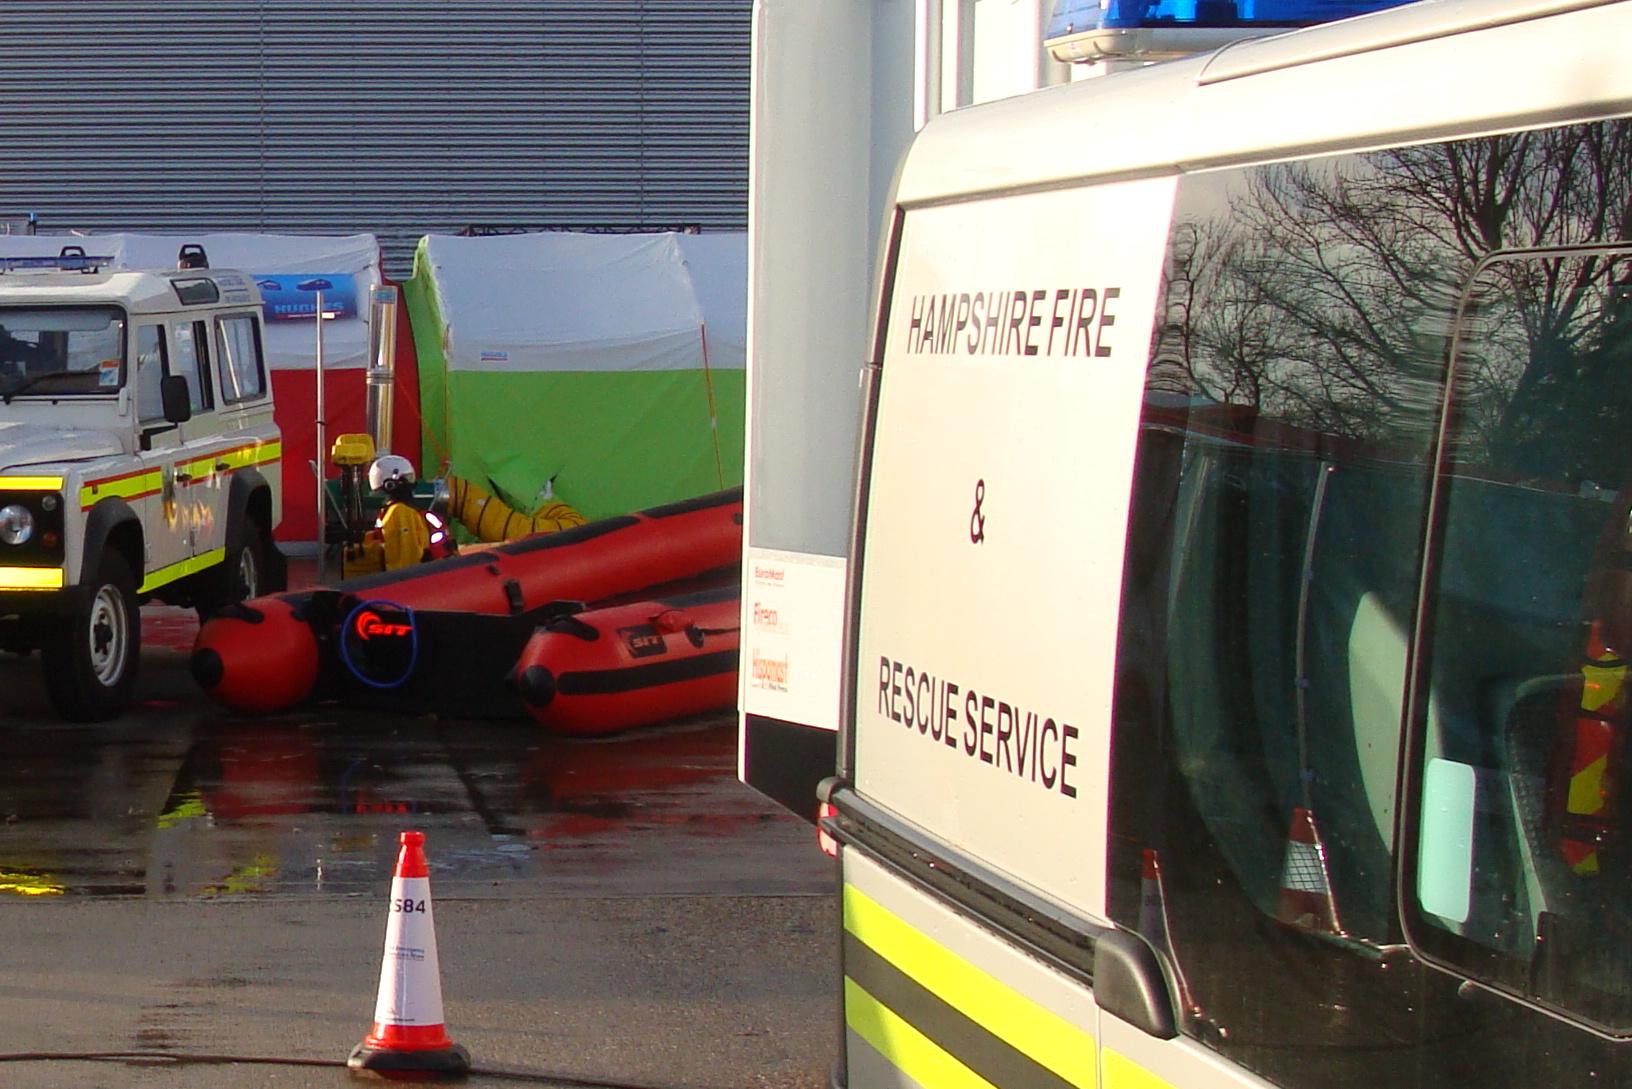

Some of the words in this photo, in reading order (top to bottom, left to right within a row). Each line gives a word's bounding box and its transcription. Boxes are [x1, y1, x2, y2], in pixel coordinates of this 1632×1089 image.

[907, 290, 1047, 356] HAMPSHIRE
[1047, 287, 1121, 357] FIRE
[970, 478, 985, 545] &
[878, 656, 959, 749] RESCUE
[964, 690, 1079, 799] SERVICE
